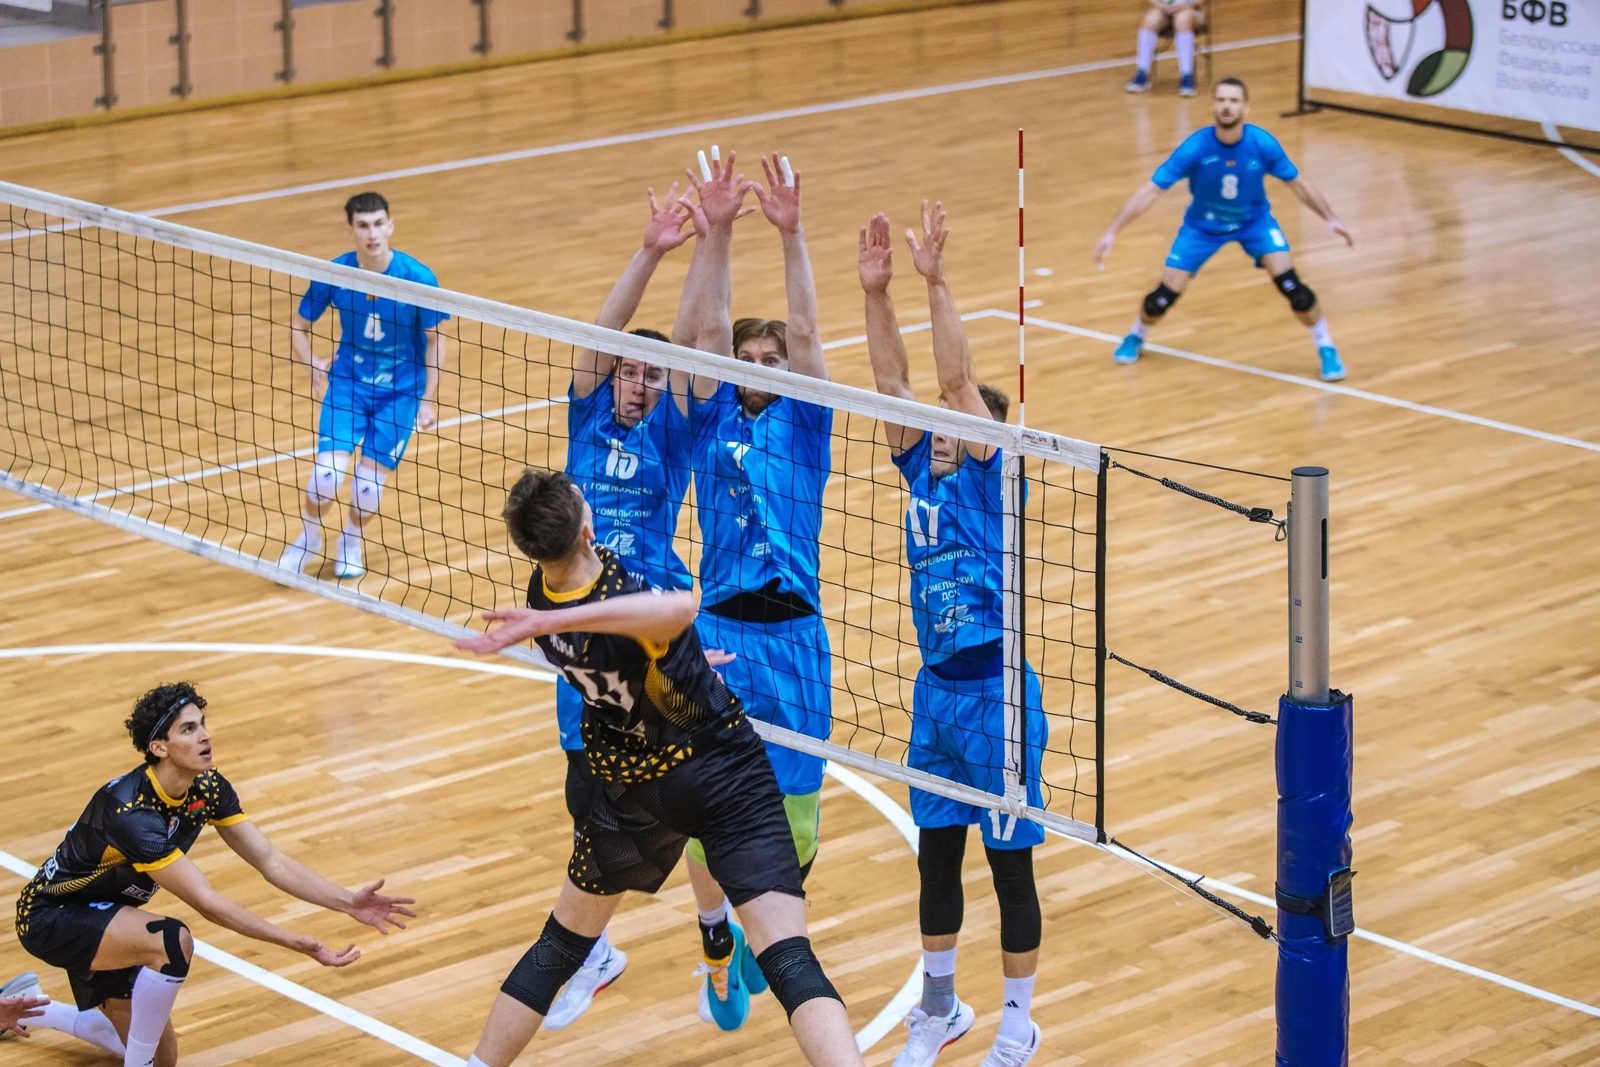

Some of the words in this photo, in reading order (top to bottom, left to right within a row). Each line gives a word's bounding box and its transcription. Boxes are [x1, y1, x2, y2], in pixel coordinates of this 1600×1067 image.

[1502, 0, 1567, 26] БФВ
[1222, 174, 1239, 200] 8
[364, 312, 386, 342] 4
[909, 497, 944, 548] 17
[988, 808, 1018, 841] 17
